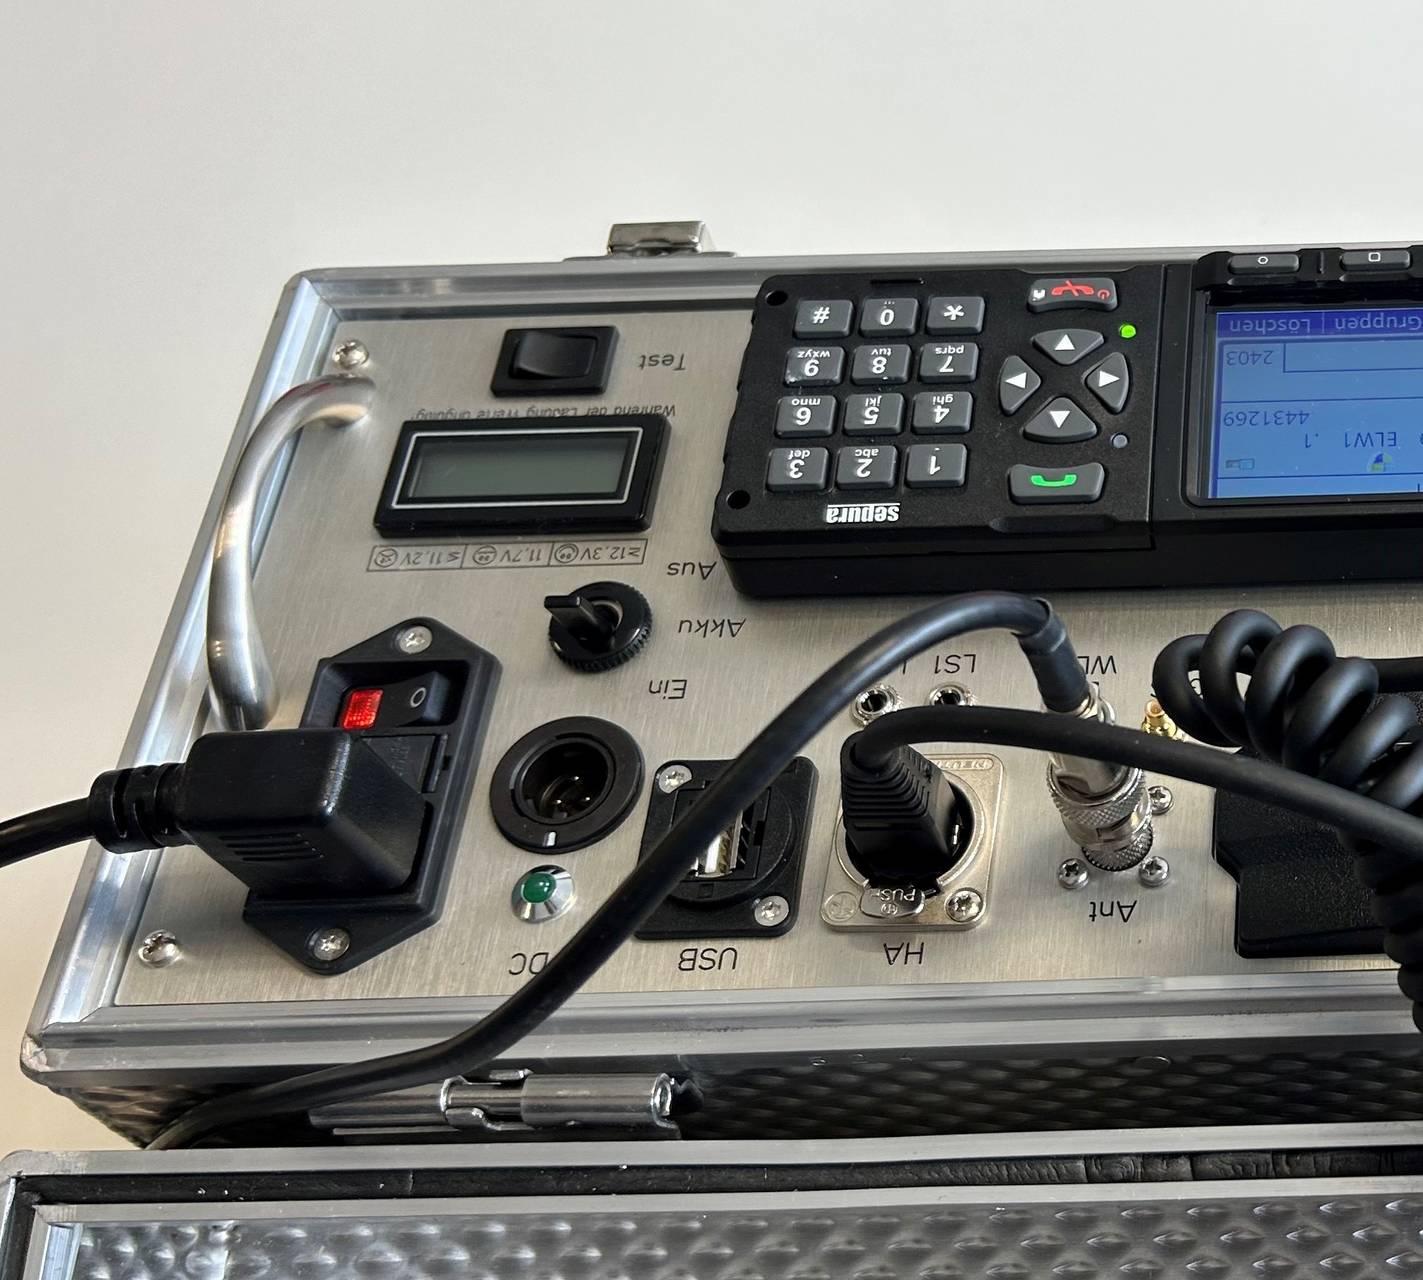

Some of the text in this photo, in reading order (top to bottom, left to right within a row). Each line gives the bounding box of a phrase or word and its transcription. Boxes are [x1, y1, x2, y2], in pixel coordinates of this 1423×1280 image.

[879, 308, 895, 326] 0
[1230, 312, 1423, 335] Gruppen Löschen
[797, 348, 831, 360] wxyz
[871, 347, 892, 357] tuv
[935, 344, 965, 358] pqrs
[1226, 349, 1275, 366] 2403
[637, 353, 687, 371] Test
[803, 358, 820, 377] 9
[871, 356, 888, 374] 8
[939, 355, 955, 373] 7
[791, 397, 821, 407] mno
[864, 395, 883, 407] jkl
[932, 394, 954, 406] ghi
[795, 406, 812, 425] 6
[863, 406, 880, 425] 5
[933, 405, 950, 424] 4
[1223, 410, 1311, 428] 4431269
[1343, 431, 1398, 449] ELW1
[788, 449, 811, 461] def
[855, 448, 880, 459] abc
[788, 459, 805, 479] 3
[855, 458, 873, 478] 2
[929, 456, 941, 475] 1
[825, 503, 901, 525] sepura
[666, 561, 717, 581] Aus
[678, 618, 747, 639] Akku
[935, 653, 977, 675] LS1
[648, 679, 688, 700] Ein
[1088, 900, 1138, 924] Ant
[678, 947, 738, 972] USB
[883, 941, 925, 966] HA
[508, 952, 550, 976] DC
